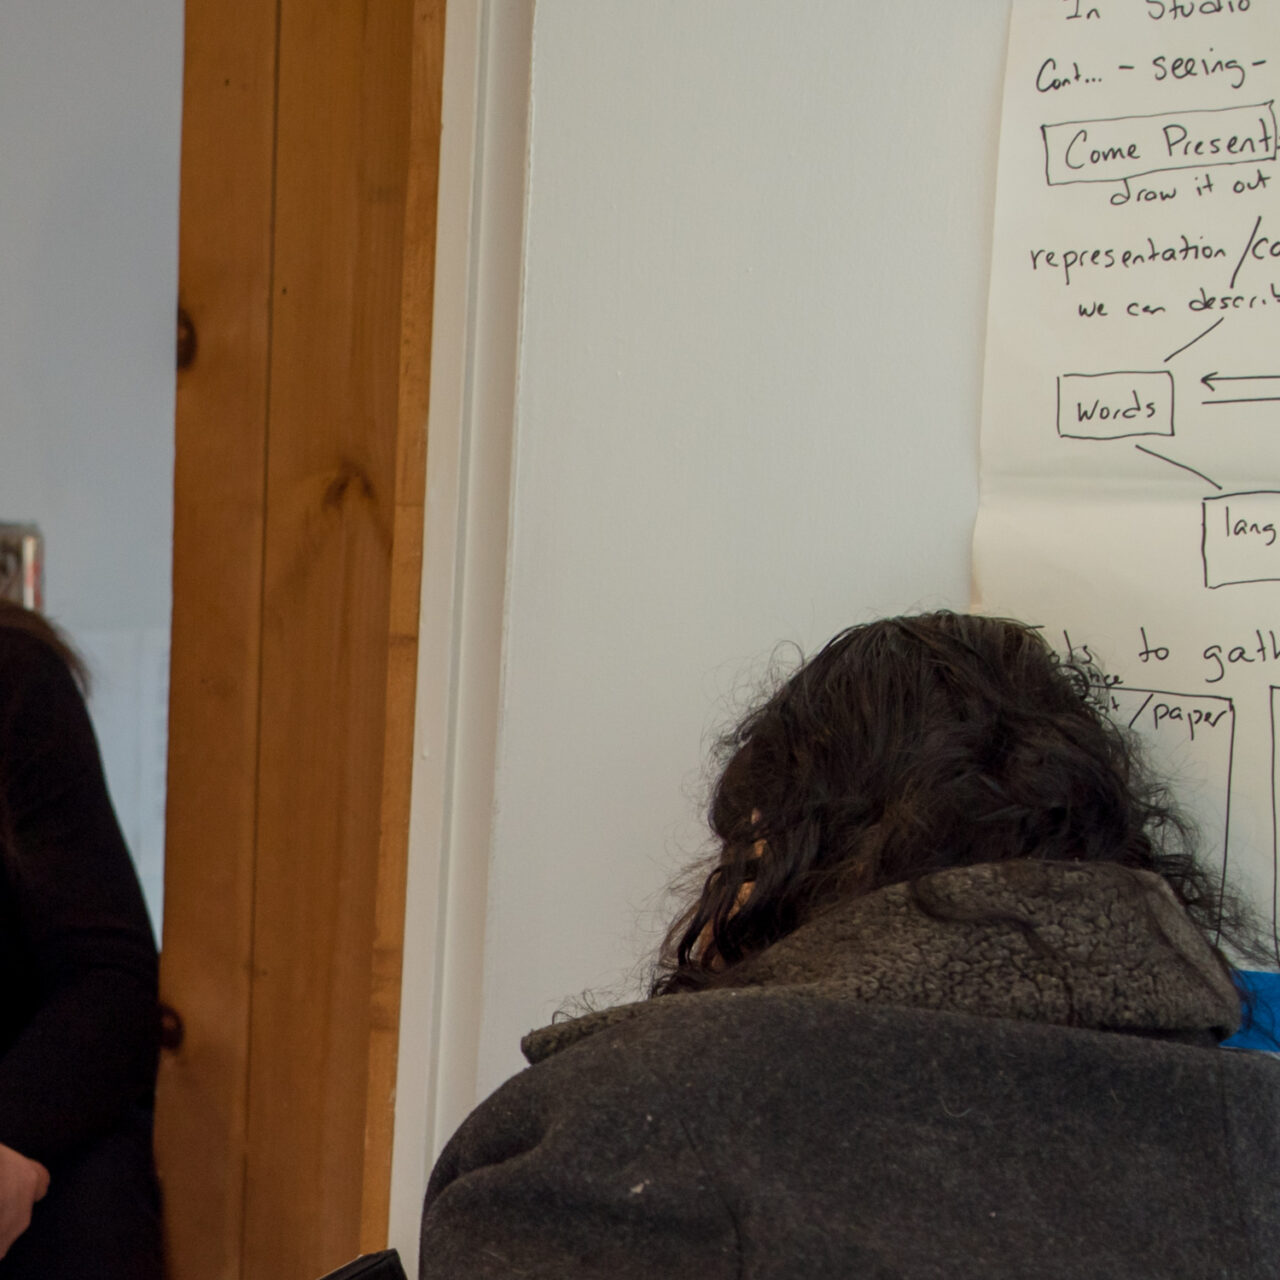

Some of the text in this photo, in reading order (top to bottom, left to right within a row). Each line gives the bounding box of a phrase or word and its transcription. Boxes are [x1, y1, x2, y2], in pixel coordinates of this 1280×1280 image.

[1065, 0, 1101, 20] In
[1065, 118, 1272, 169] Come Present
[1110, 169, 1272, 206] draw it out
[1138, 627, 1169, 663] to
